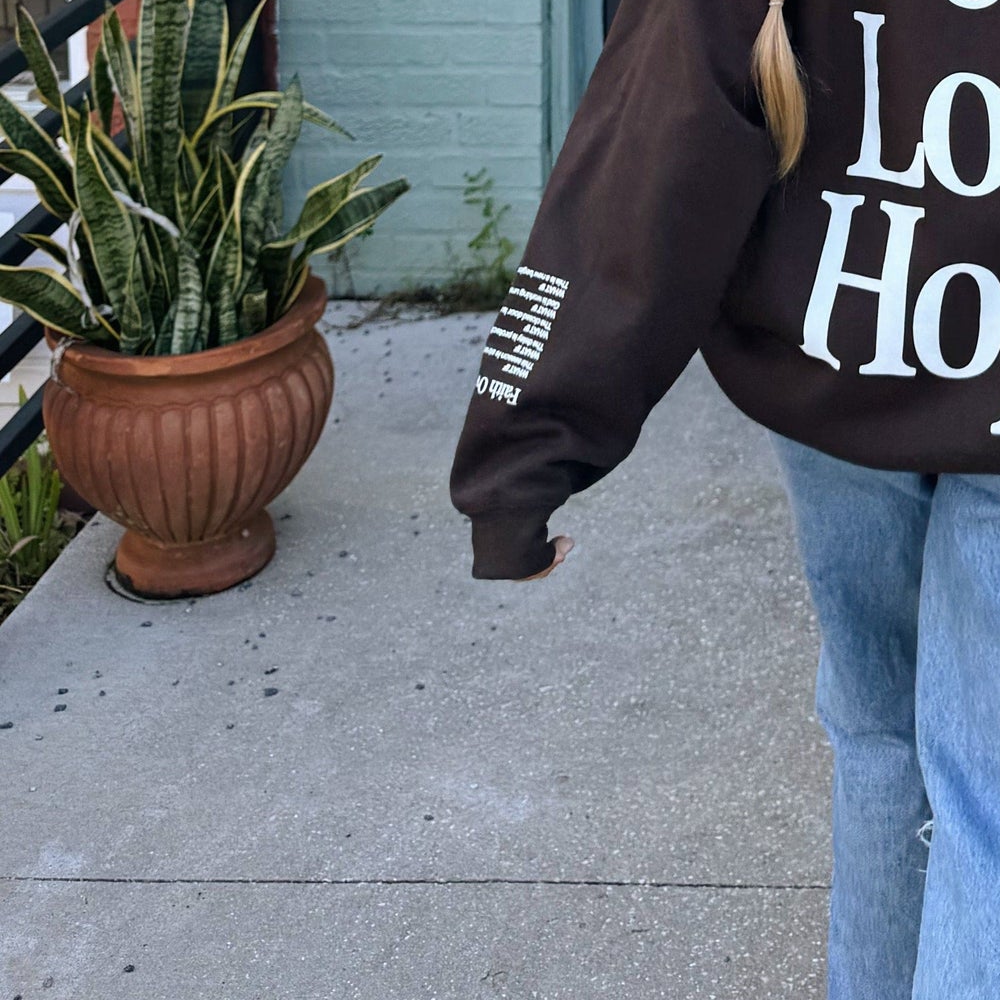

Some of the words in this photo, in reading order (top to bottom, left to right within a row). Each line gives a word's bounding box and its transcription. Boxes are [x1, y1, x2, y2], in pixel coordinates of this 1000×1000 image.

[544, 284, 565, 299] WHAT
[536, 305, 556, 319] WHAT
[528, 325, 549, 340] WHAT
[519, 346, 542, 361] WHAT
[507, 365, 529, 379] WHAT
[489, 379, 521, 405] Faith
